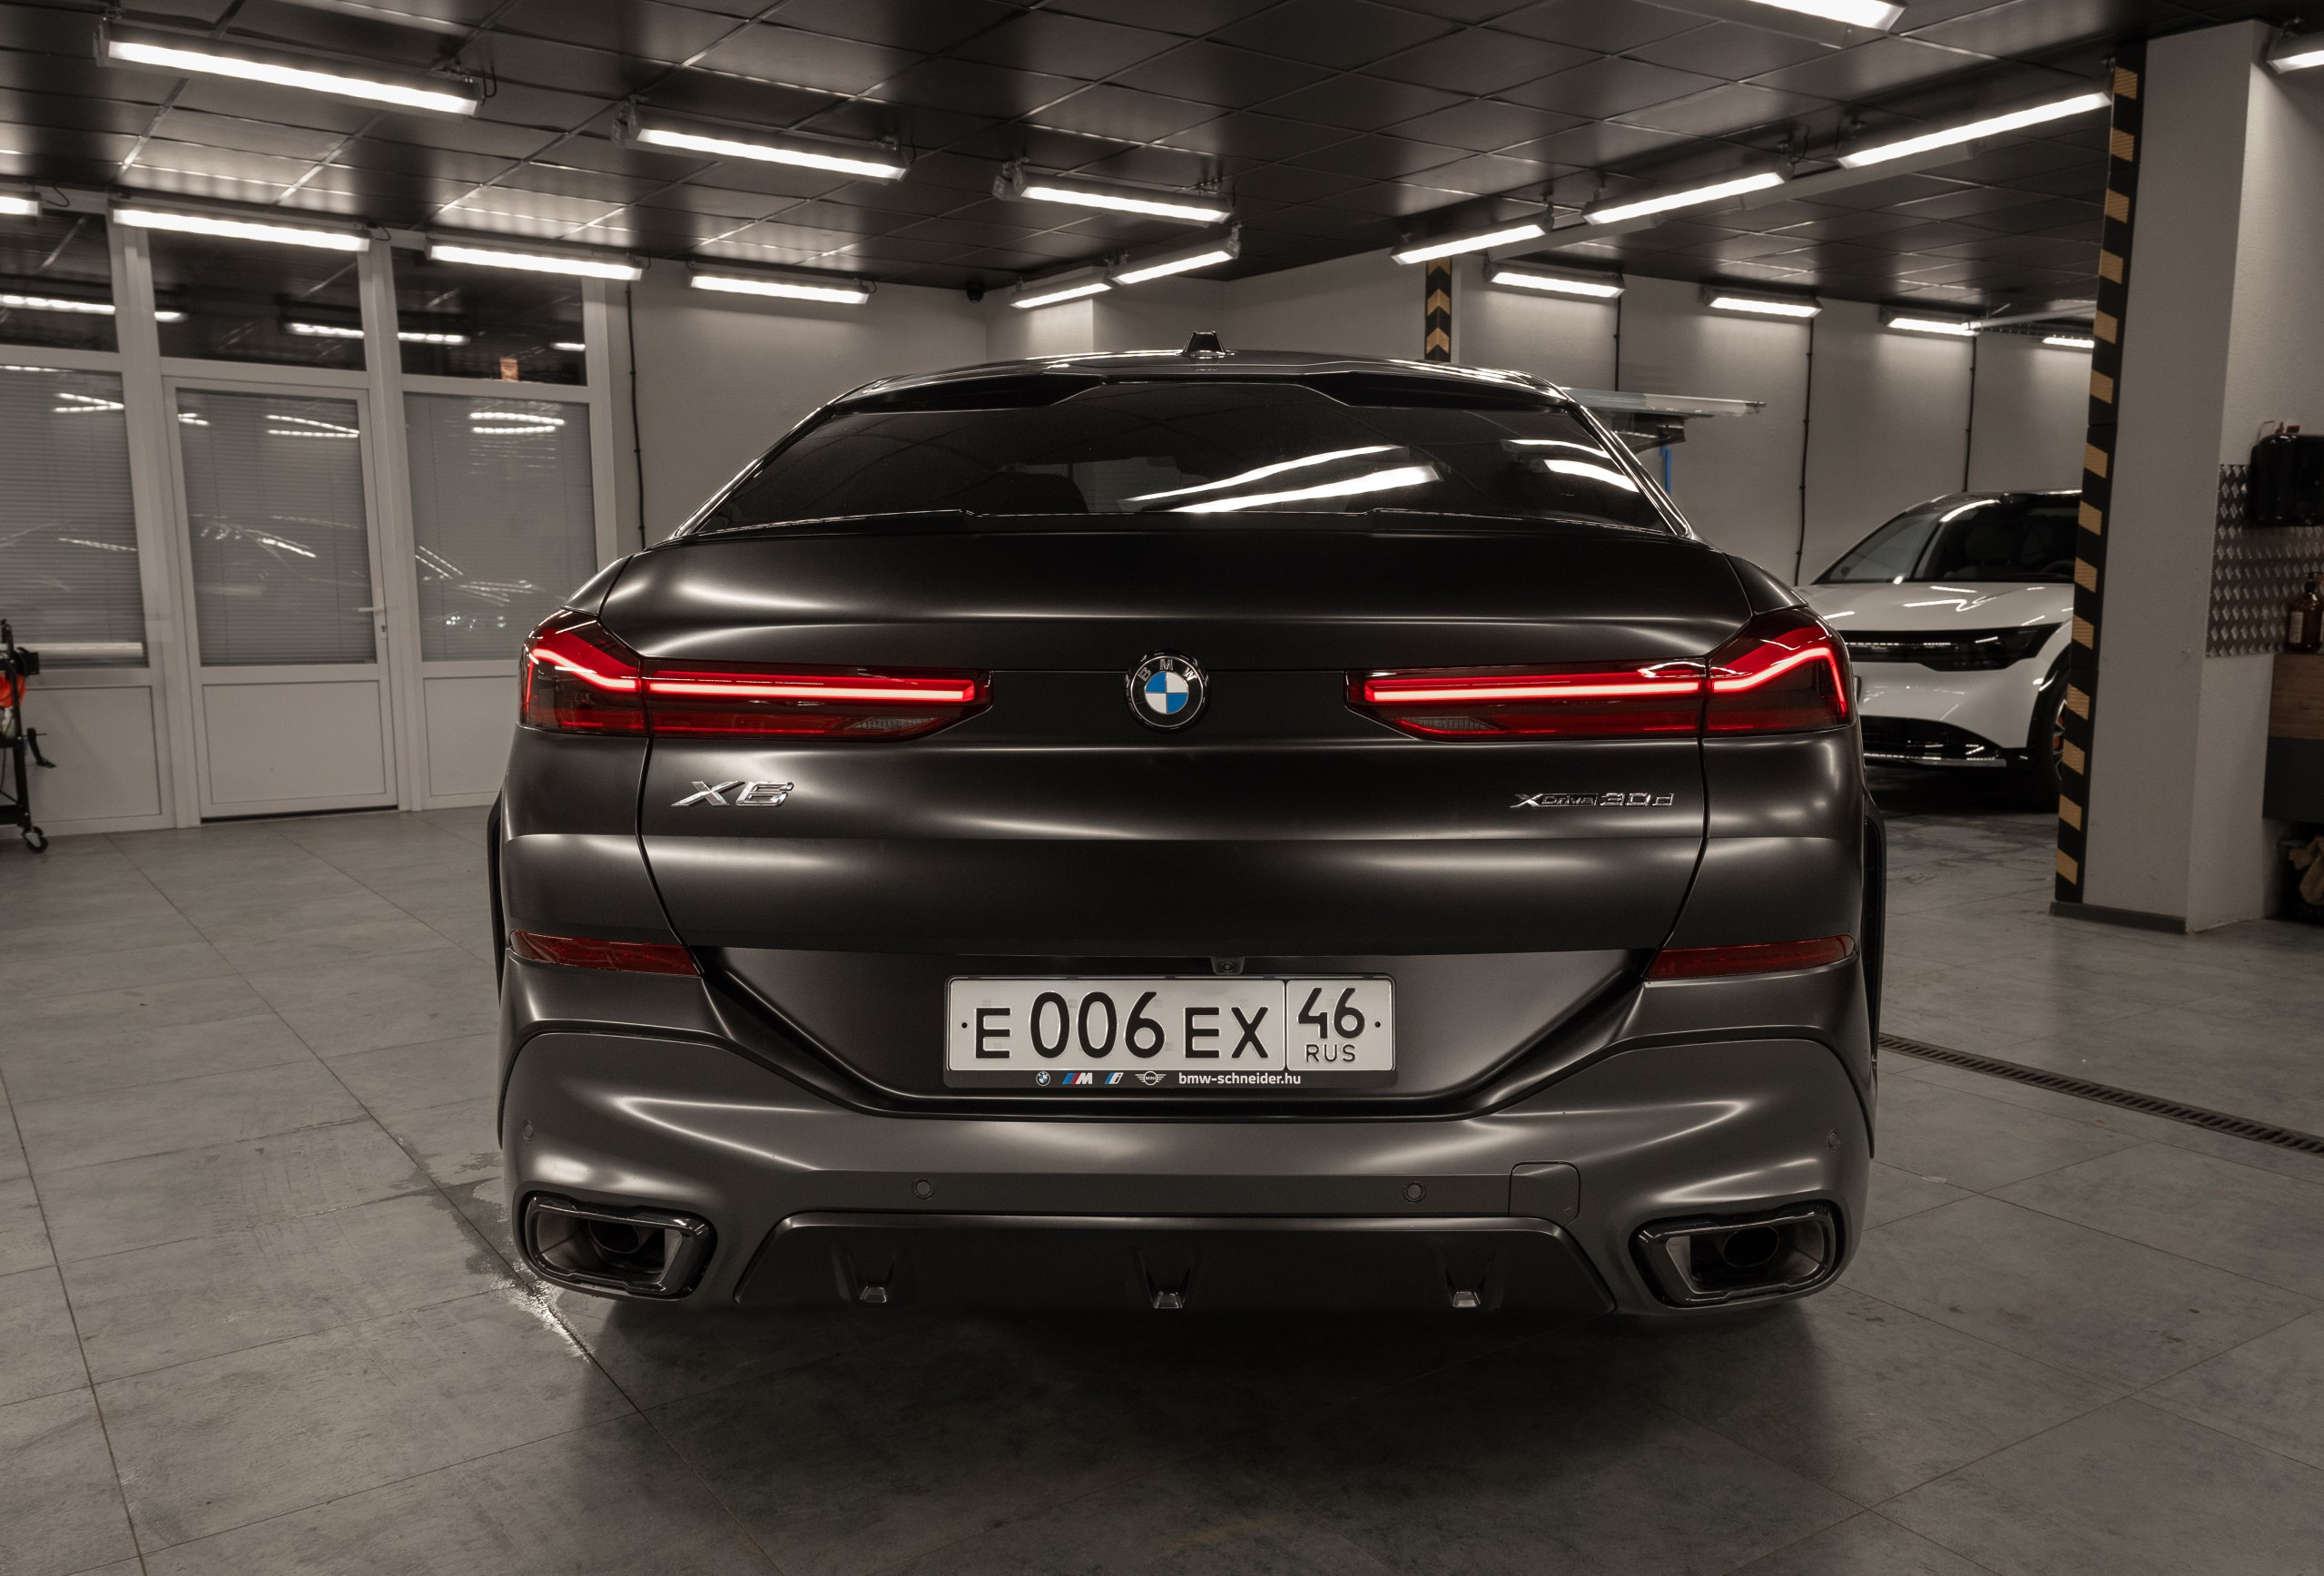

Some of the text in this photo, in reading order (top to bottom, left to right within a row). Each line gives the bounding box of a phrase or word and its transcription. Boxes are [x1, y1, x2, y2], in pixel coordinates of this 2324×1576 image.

[1137, 658, 1198, 682] BMW
[671, 781, 795, 807] X6
[1029, 991, 1166, 1059] 006
[1185, 1007, 1269, 1059] EX
[1298, 987, 1365, 1039] 46
[1305, 1044, 1356, 1063] RUS
[1178, 1072, 1301, 1085] bmw-schneider.hu
